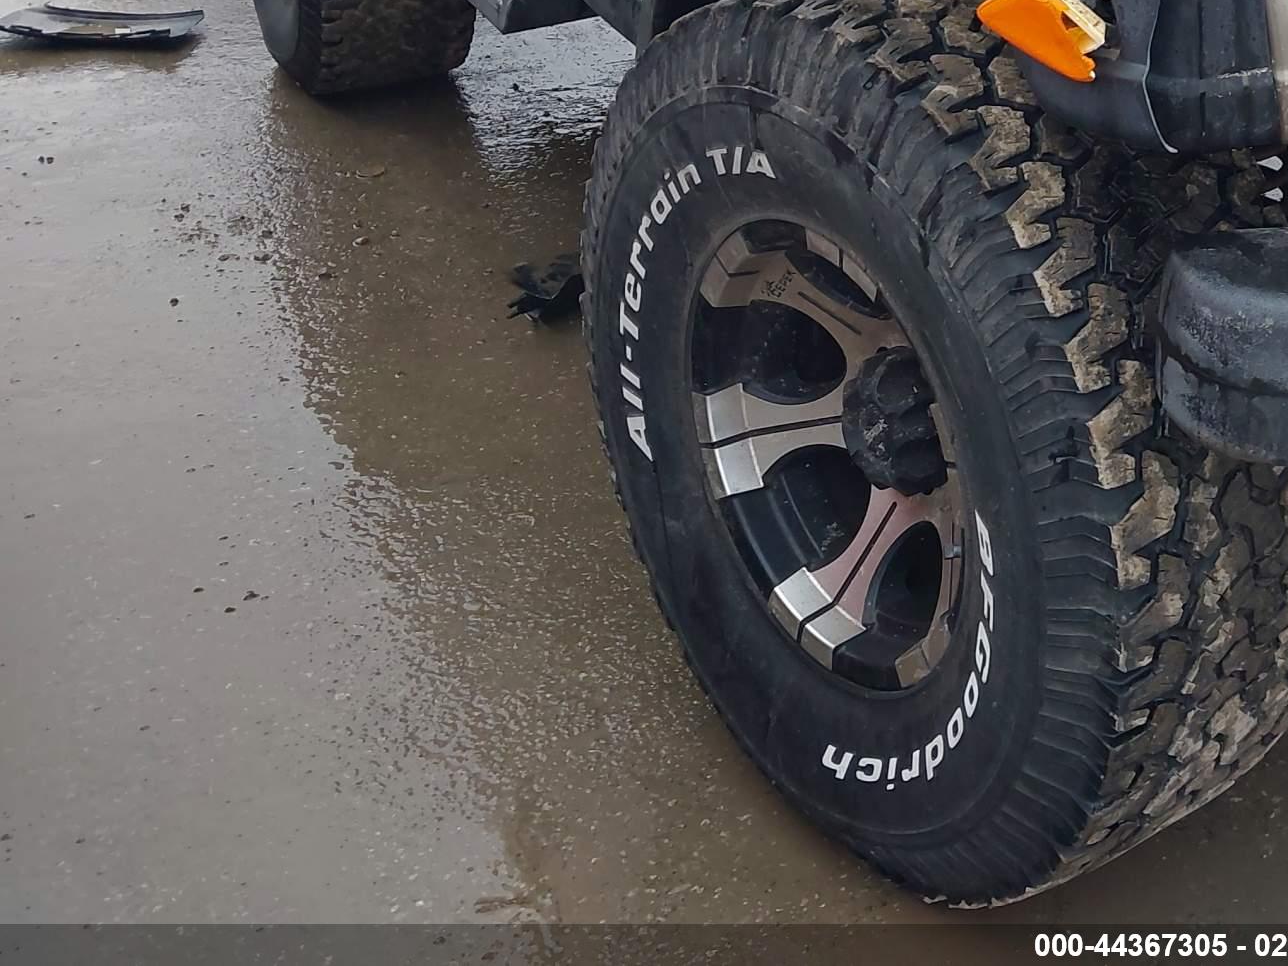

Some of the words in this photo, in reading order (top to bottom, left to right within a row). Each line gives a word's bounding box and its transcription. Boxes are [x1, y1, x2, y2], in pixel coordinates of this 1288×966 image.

[619, 162, 702, 462] All-Terrain
[705, 145, 777, 180] T/A
[821, 508, 995, 791] BFGoodrich
